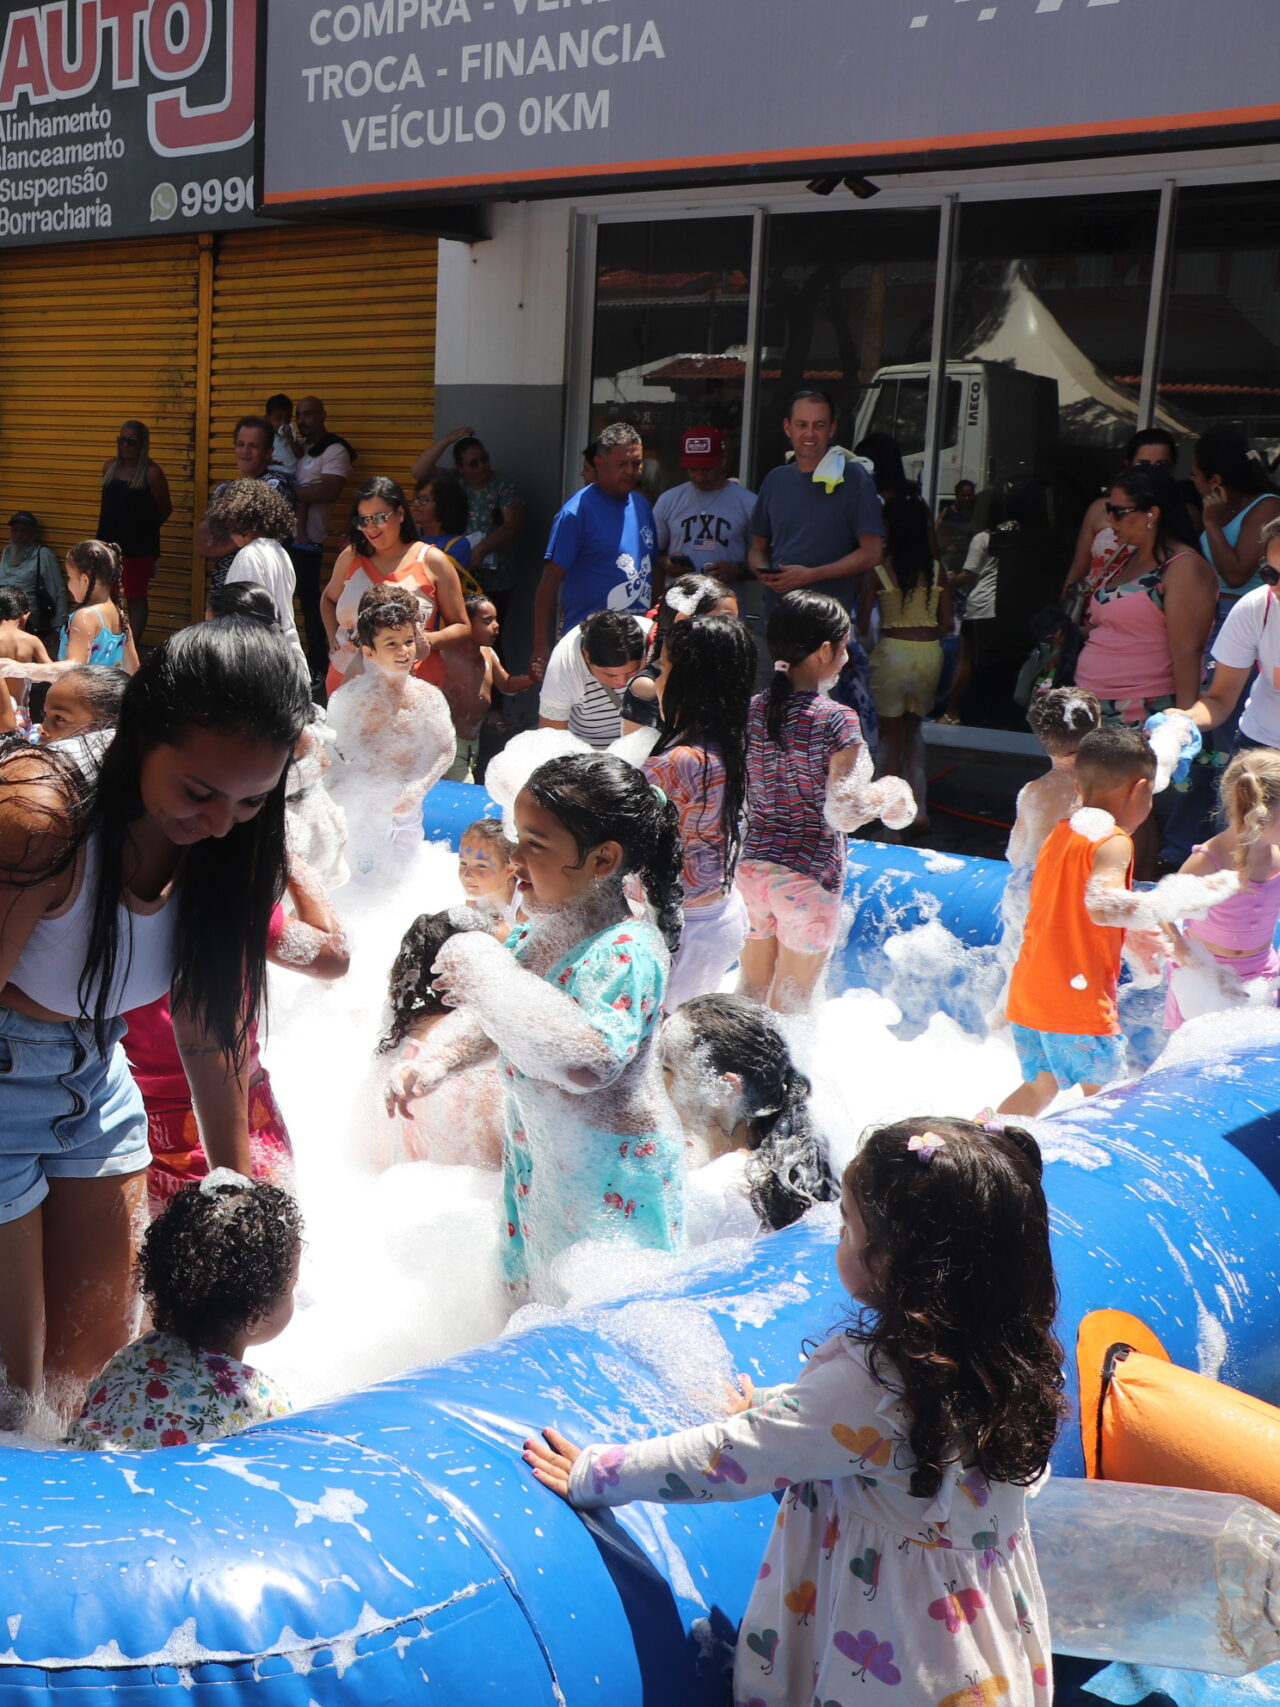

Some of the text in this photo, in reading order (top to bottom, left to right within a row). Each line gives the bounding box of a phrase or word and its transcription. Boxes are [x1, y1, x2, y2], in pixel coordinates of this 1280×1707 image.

[309, 0, 472, 46] COMPRA
[147, 0, 255, 157] J
[301, 53, 426, 103] TROCA
[460, 20, 666, 83] FINANCIA
[341, 89, 610, 154] VEÍCULO 0KM
[681, 514, 732, 548] TXC
